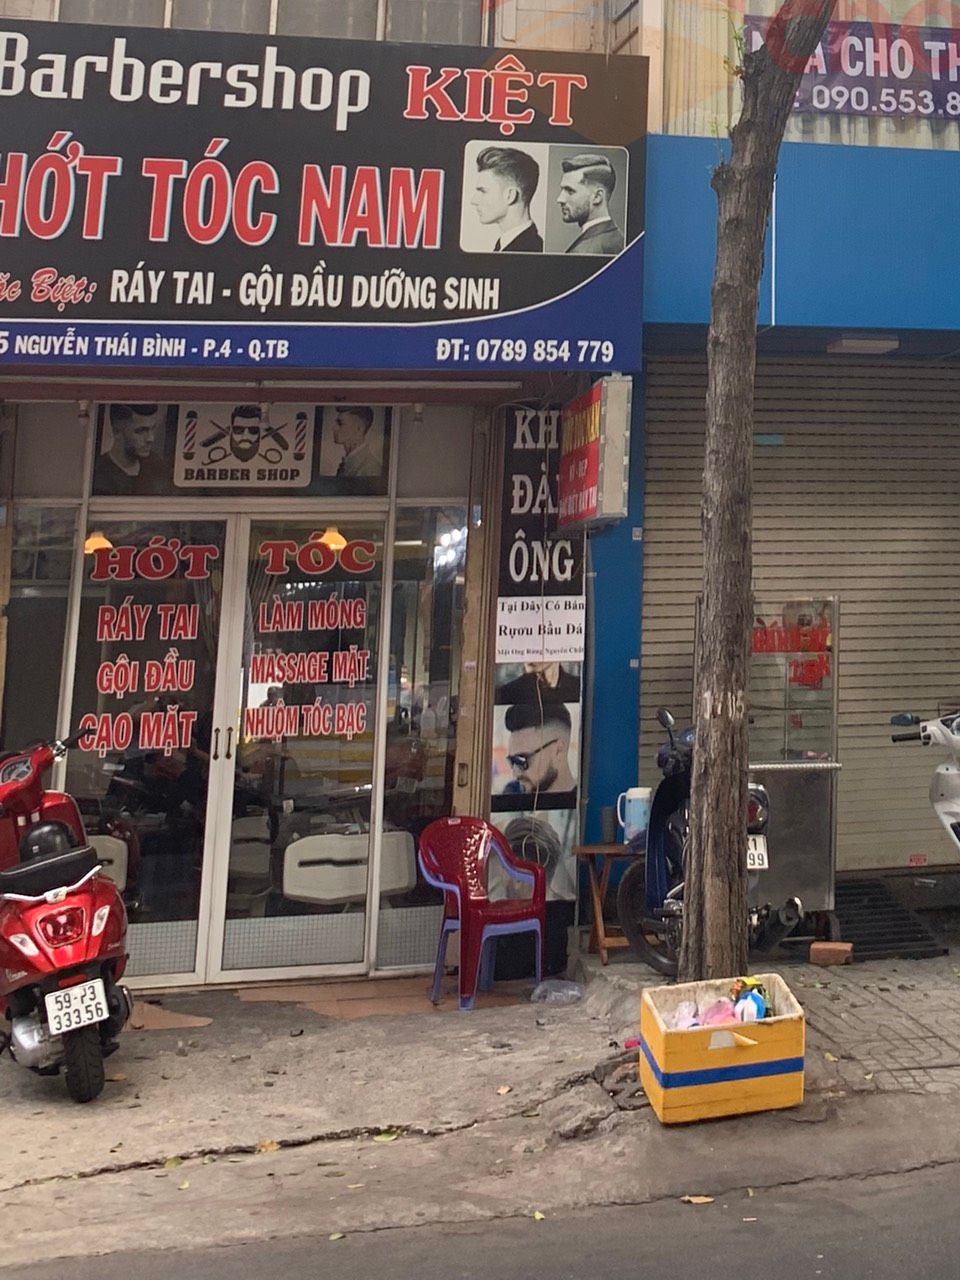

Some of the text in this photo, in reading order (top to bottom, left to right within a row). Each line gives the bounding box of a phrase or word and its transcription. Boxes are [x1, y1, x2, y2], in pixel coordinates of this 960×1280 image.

[839, 35, 915, 80] CHO
[0, 31, 588, 136] Barbershop KIỆT
[142, 137, 279, 246] TÓC
[298, 164, 446, 251] NAM
[110, 261, 162, 304] RÁY
[173, 271, 214, 305] TAI
[238, 263, 283, 314] GỘI
[290, 259, 344, 310] ĐẦU
[350, 268, 437, 308] DƯỠNG
[443, 276, 500, 312] SINH
[14, 327, 89, 356] NGUYỄN
[94, 329, 138, 357] THÁI
[143, 329, 186, 358] BÌNH
[202, 337, 232, 359] P.4
[248, 338, 290, 361] Q.TB
[436, 338, 471, 362] ĐT:
[475, 339, 528, 363] 0789
[533, 339, 573, 363] 854
[577, 340, 615, 364] 779
[184, 467, 300, 482] BARBER SHOP
[510, 461, 562, 515] ĐÀ
[90, 531, 376, 581] HỚT TÓC
[508, 528, 575, 584] ÔNG
[97, 596, 200, 642] RÁY TAI
[259, 592, 367, 633] LÀM MÓNG
[545, 600, 561, 611] Có
[564, 600, 585, 611] Bán
[499, 624, 533, 639] Rượu
[97, 648, 195, 699] GỘI ĐẦU
[250, 645, 370, 688] MASSAGE MẶT
[78, 704, 197, 758] CẠO MẶT
[244, 696, 366, 743] NHUỘM TÓC BẠC
